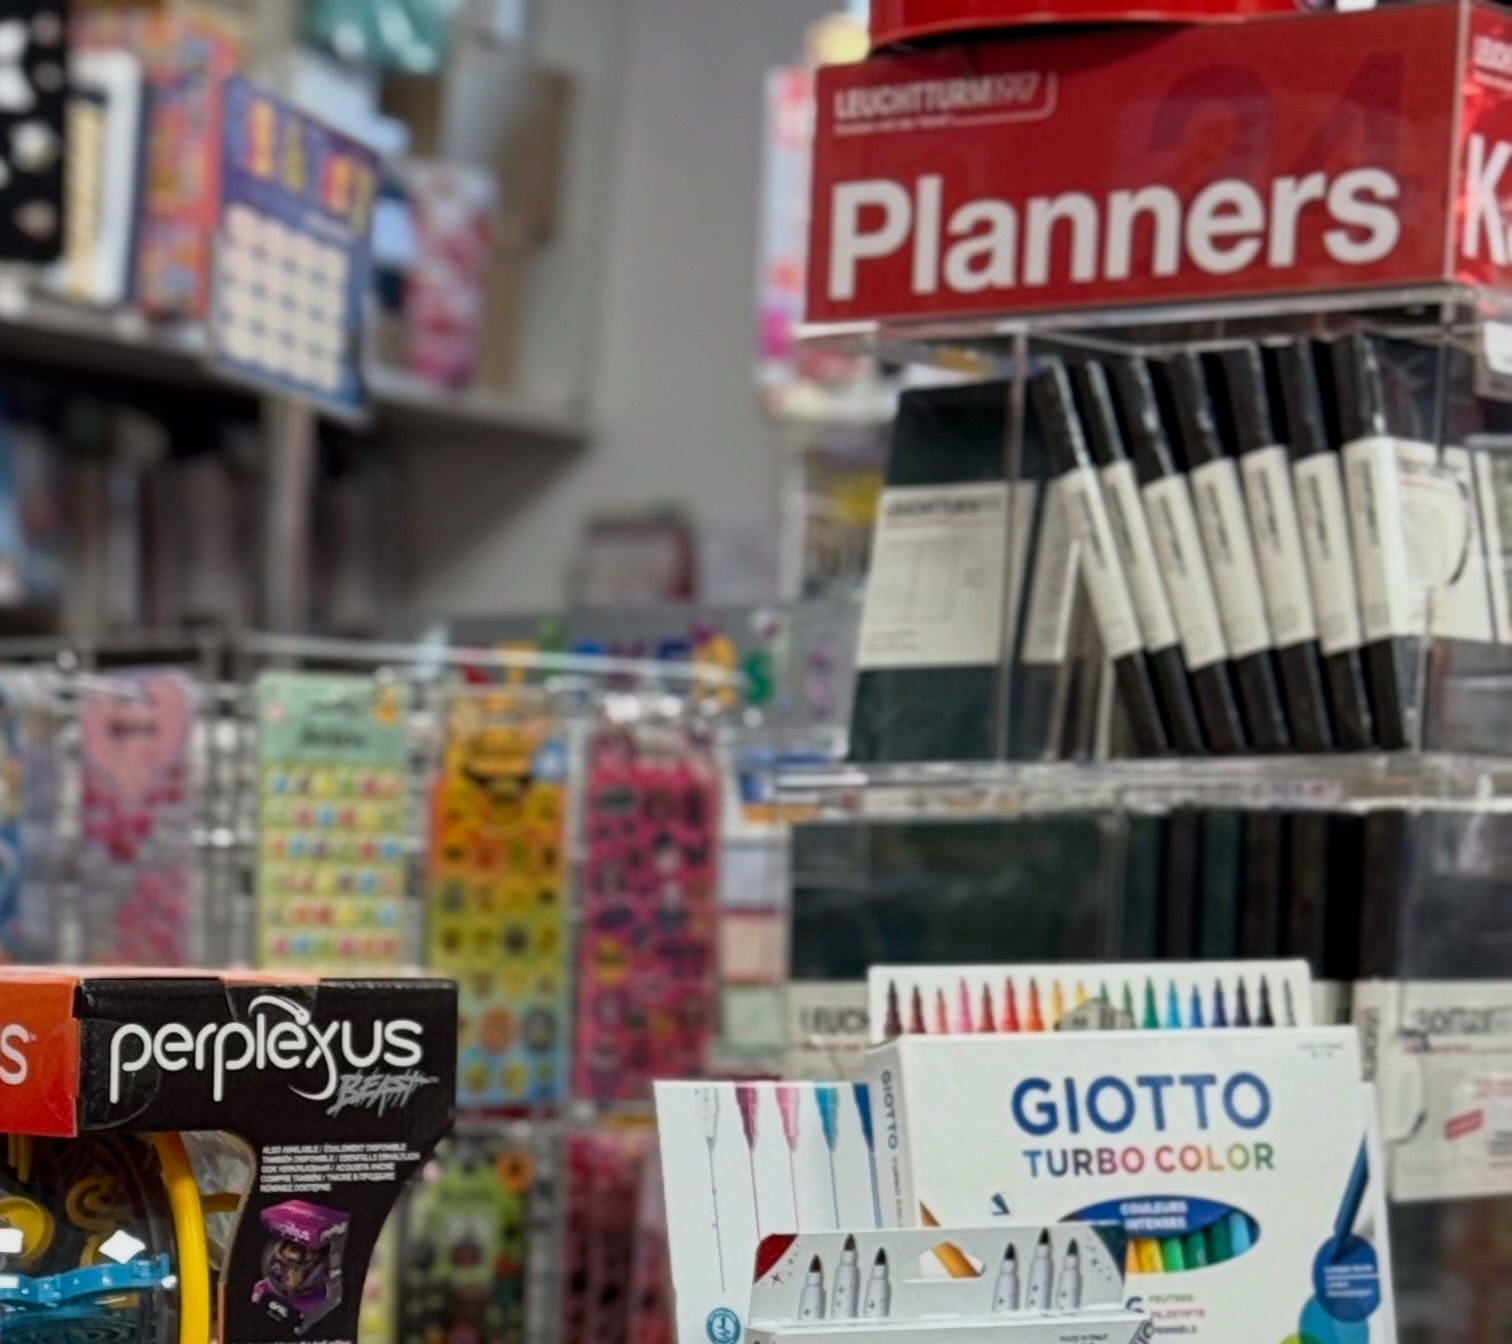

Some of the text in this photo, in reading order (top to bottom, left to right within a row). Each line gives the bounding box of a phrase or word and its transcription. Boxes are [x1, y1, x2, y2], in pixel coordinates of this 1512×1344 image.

[828, 168, 1400, 301] Planners
[109, 995, 423, 1102] perplexus
[1011, 1072, 1271, 1137] GIOTTO
[1022, 1143, 1275, 1177] TURBO COLOR
